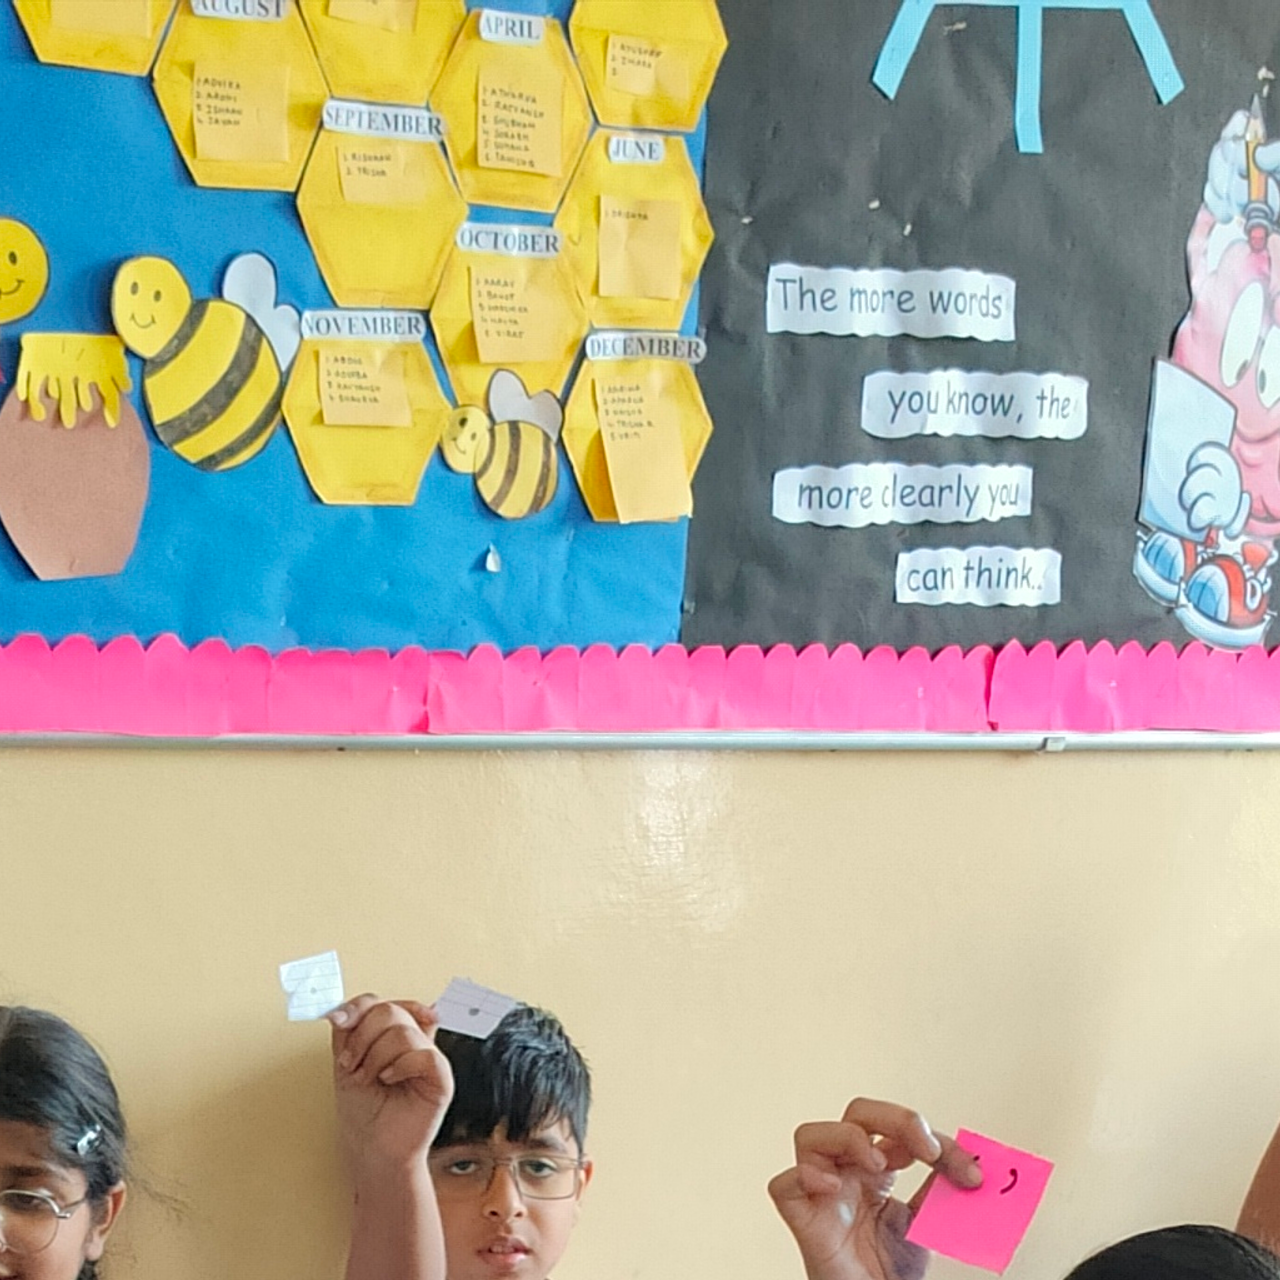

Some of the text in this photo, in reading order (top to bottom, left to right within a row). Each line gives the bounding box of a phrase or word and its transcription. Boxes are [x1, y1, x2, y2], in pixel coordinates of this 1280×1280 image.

[195, 0, 284, 18] AUGUST
[484, 15, 541, 41] APRIL
[325, 107, 442, 136] SEPTEMBER
[612, 140, 661, 161] JUNE
[459, 229, 560, 253] OCTOBER
[775, 277, 1003, 319] The more words
[303, 316, 422, 335] NOVEMBER
[590, 336, 702, 359] DECEMBER
[887, 380, 1071, 424] you know, the
[798, 473, 1020, 517] more clearly you
[907, 563, 956, 593] can
